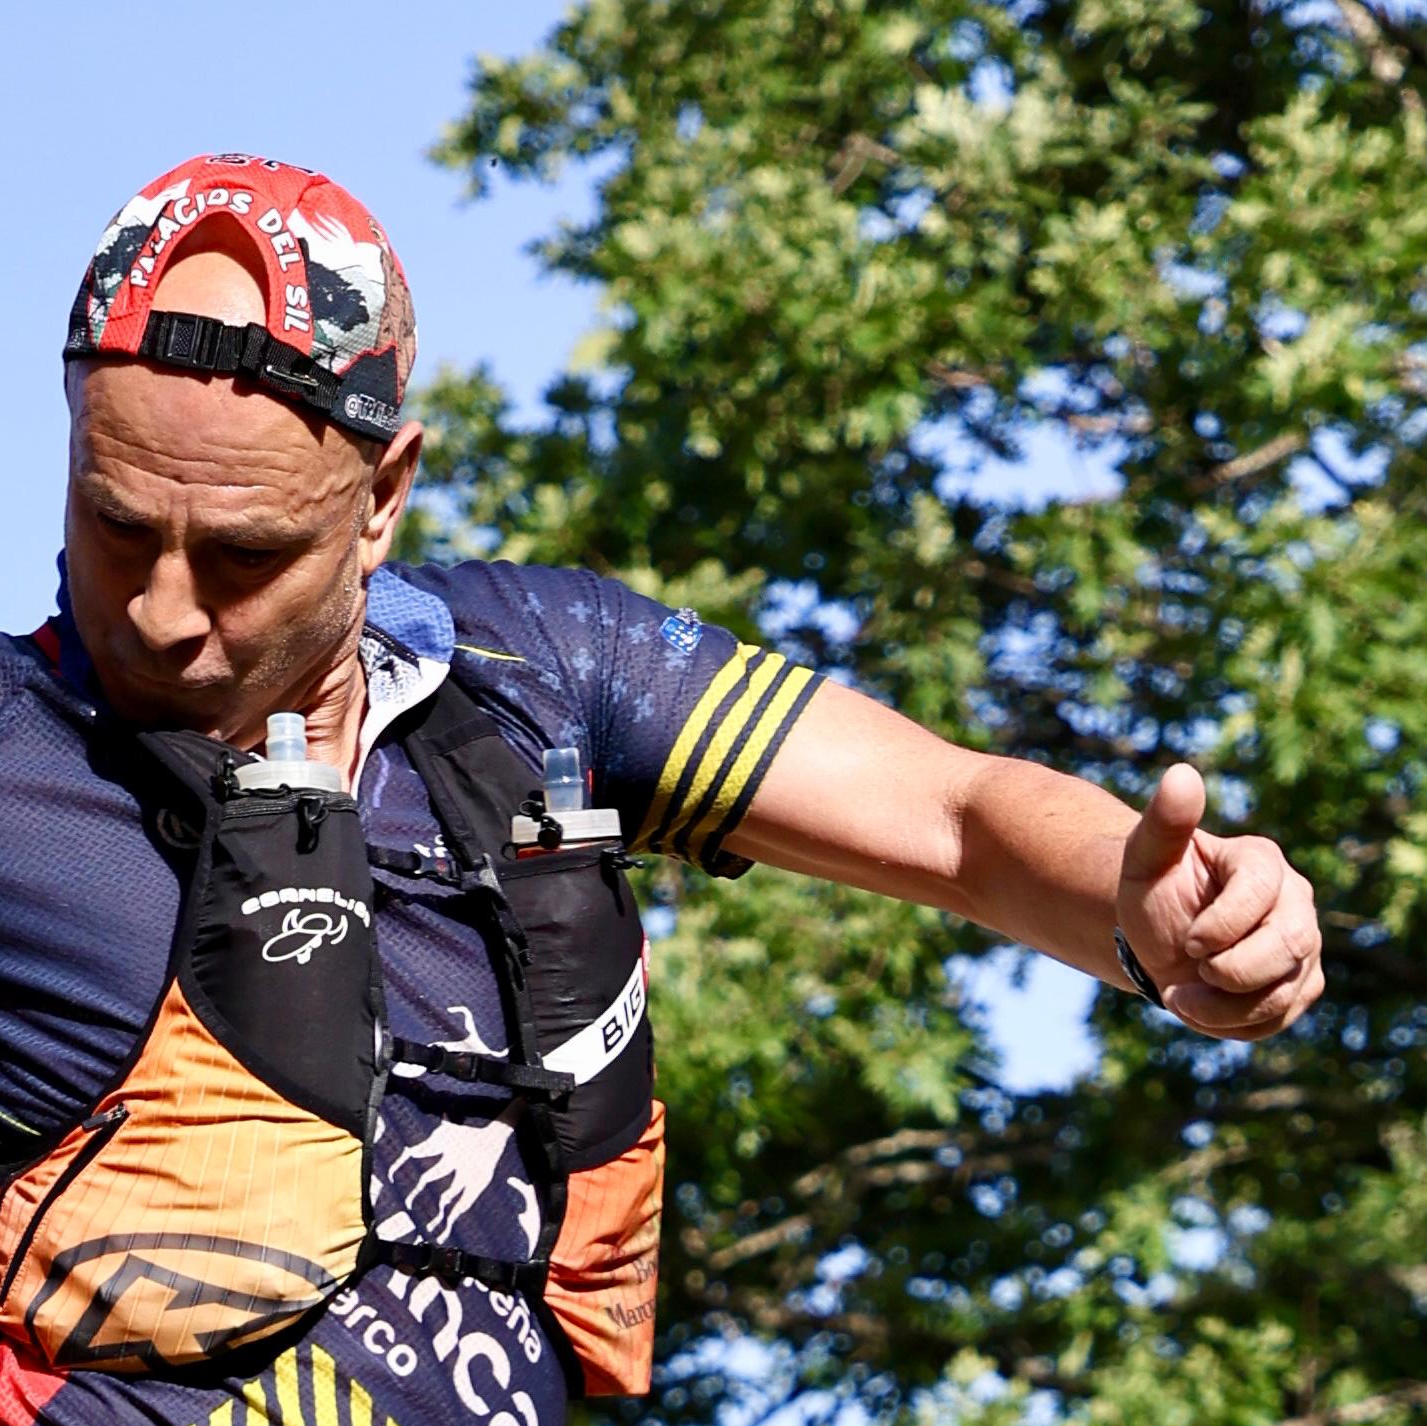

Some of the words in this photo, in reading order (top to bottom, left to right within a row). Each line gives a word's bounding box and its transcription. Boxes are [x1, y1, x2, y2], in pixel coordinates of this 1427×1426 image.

[129, 186, 254, 289] PALACIOS
[256, 207, 302, 273] DEL
[283, 283, 311, 333] SIL
